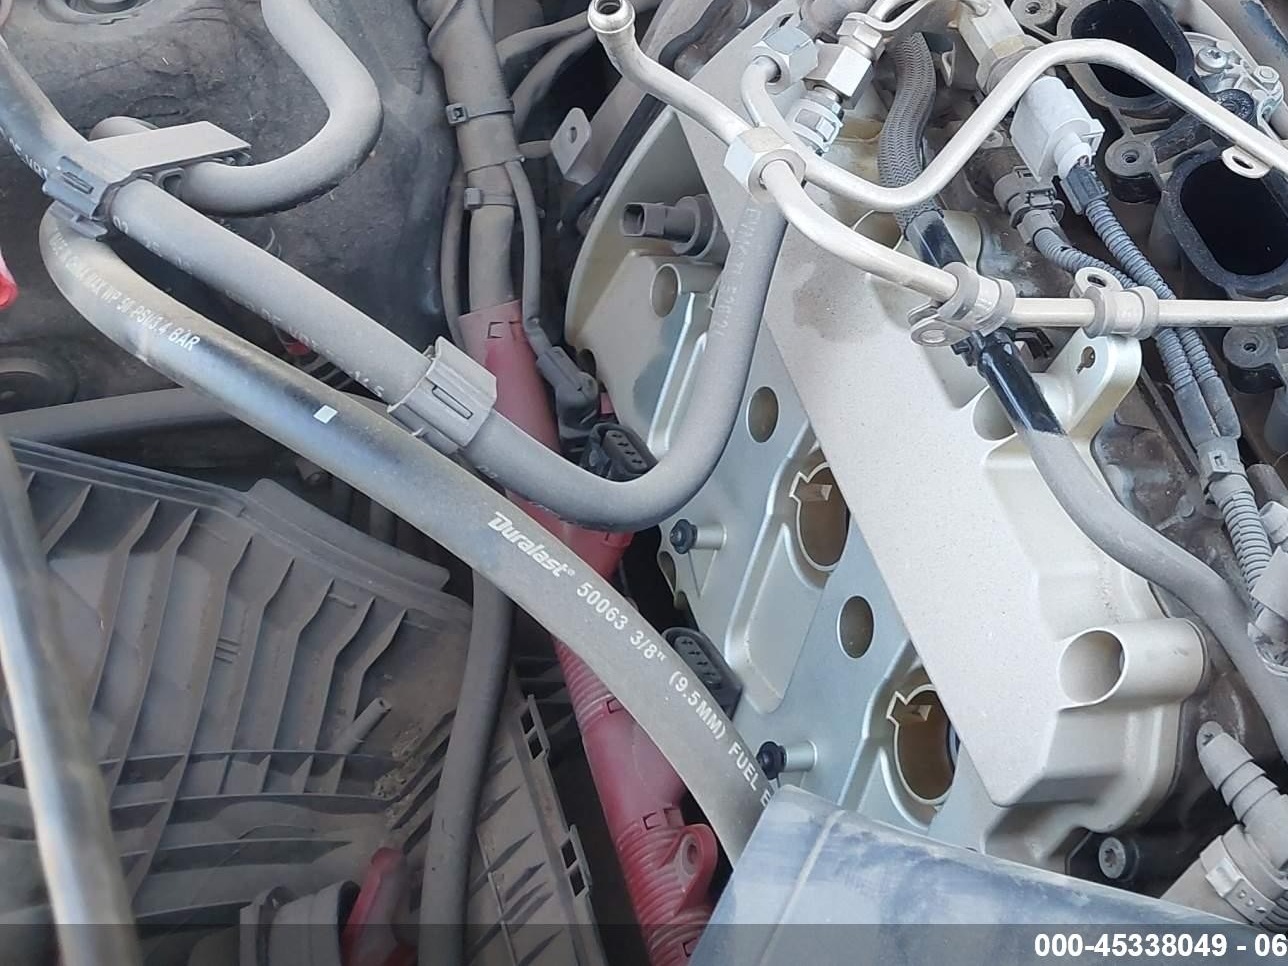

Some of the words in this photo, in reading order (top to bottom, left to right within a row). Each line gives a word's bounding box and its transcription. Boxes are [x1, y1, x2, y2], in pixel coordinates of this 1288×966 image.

[167, 326, 201, 352] BAR
[575, 581, 629, 631] 50063
[629, 630, 667, 661] 3/8"
[668, 670, 727, 740] (9.5MM)
[727, 741, 760, 792] FUEL
